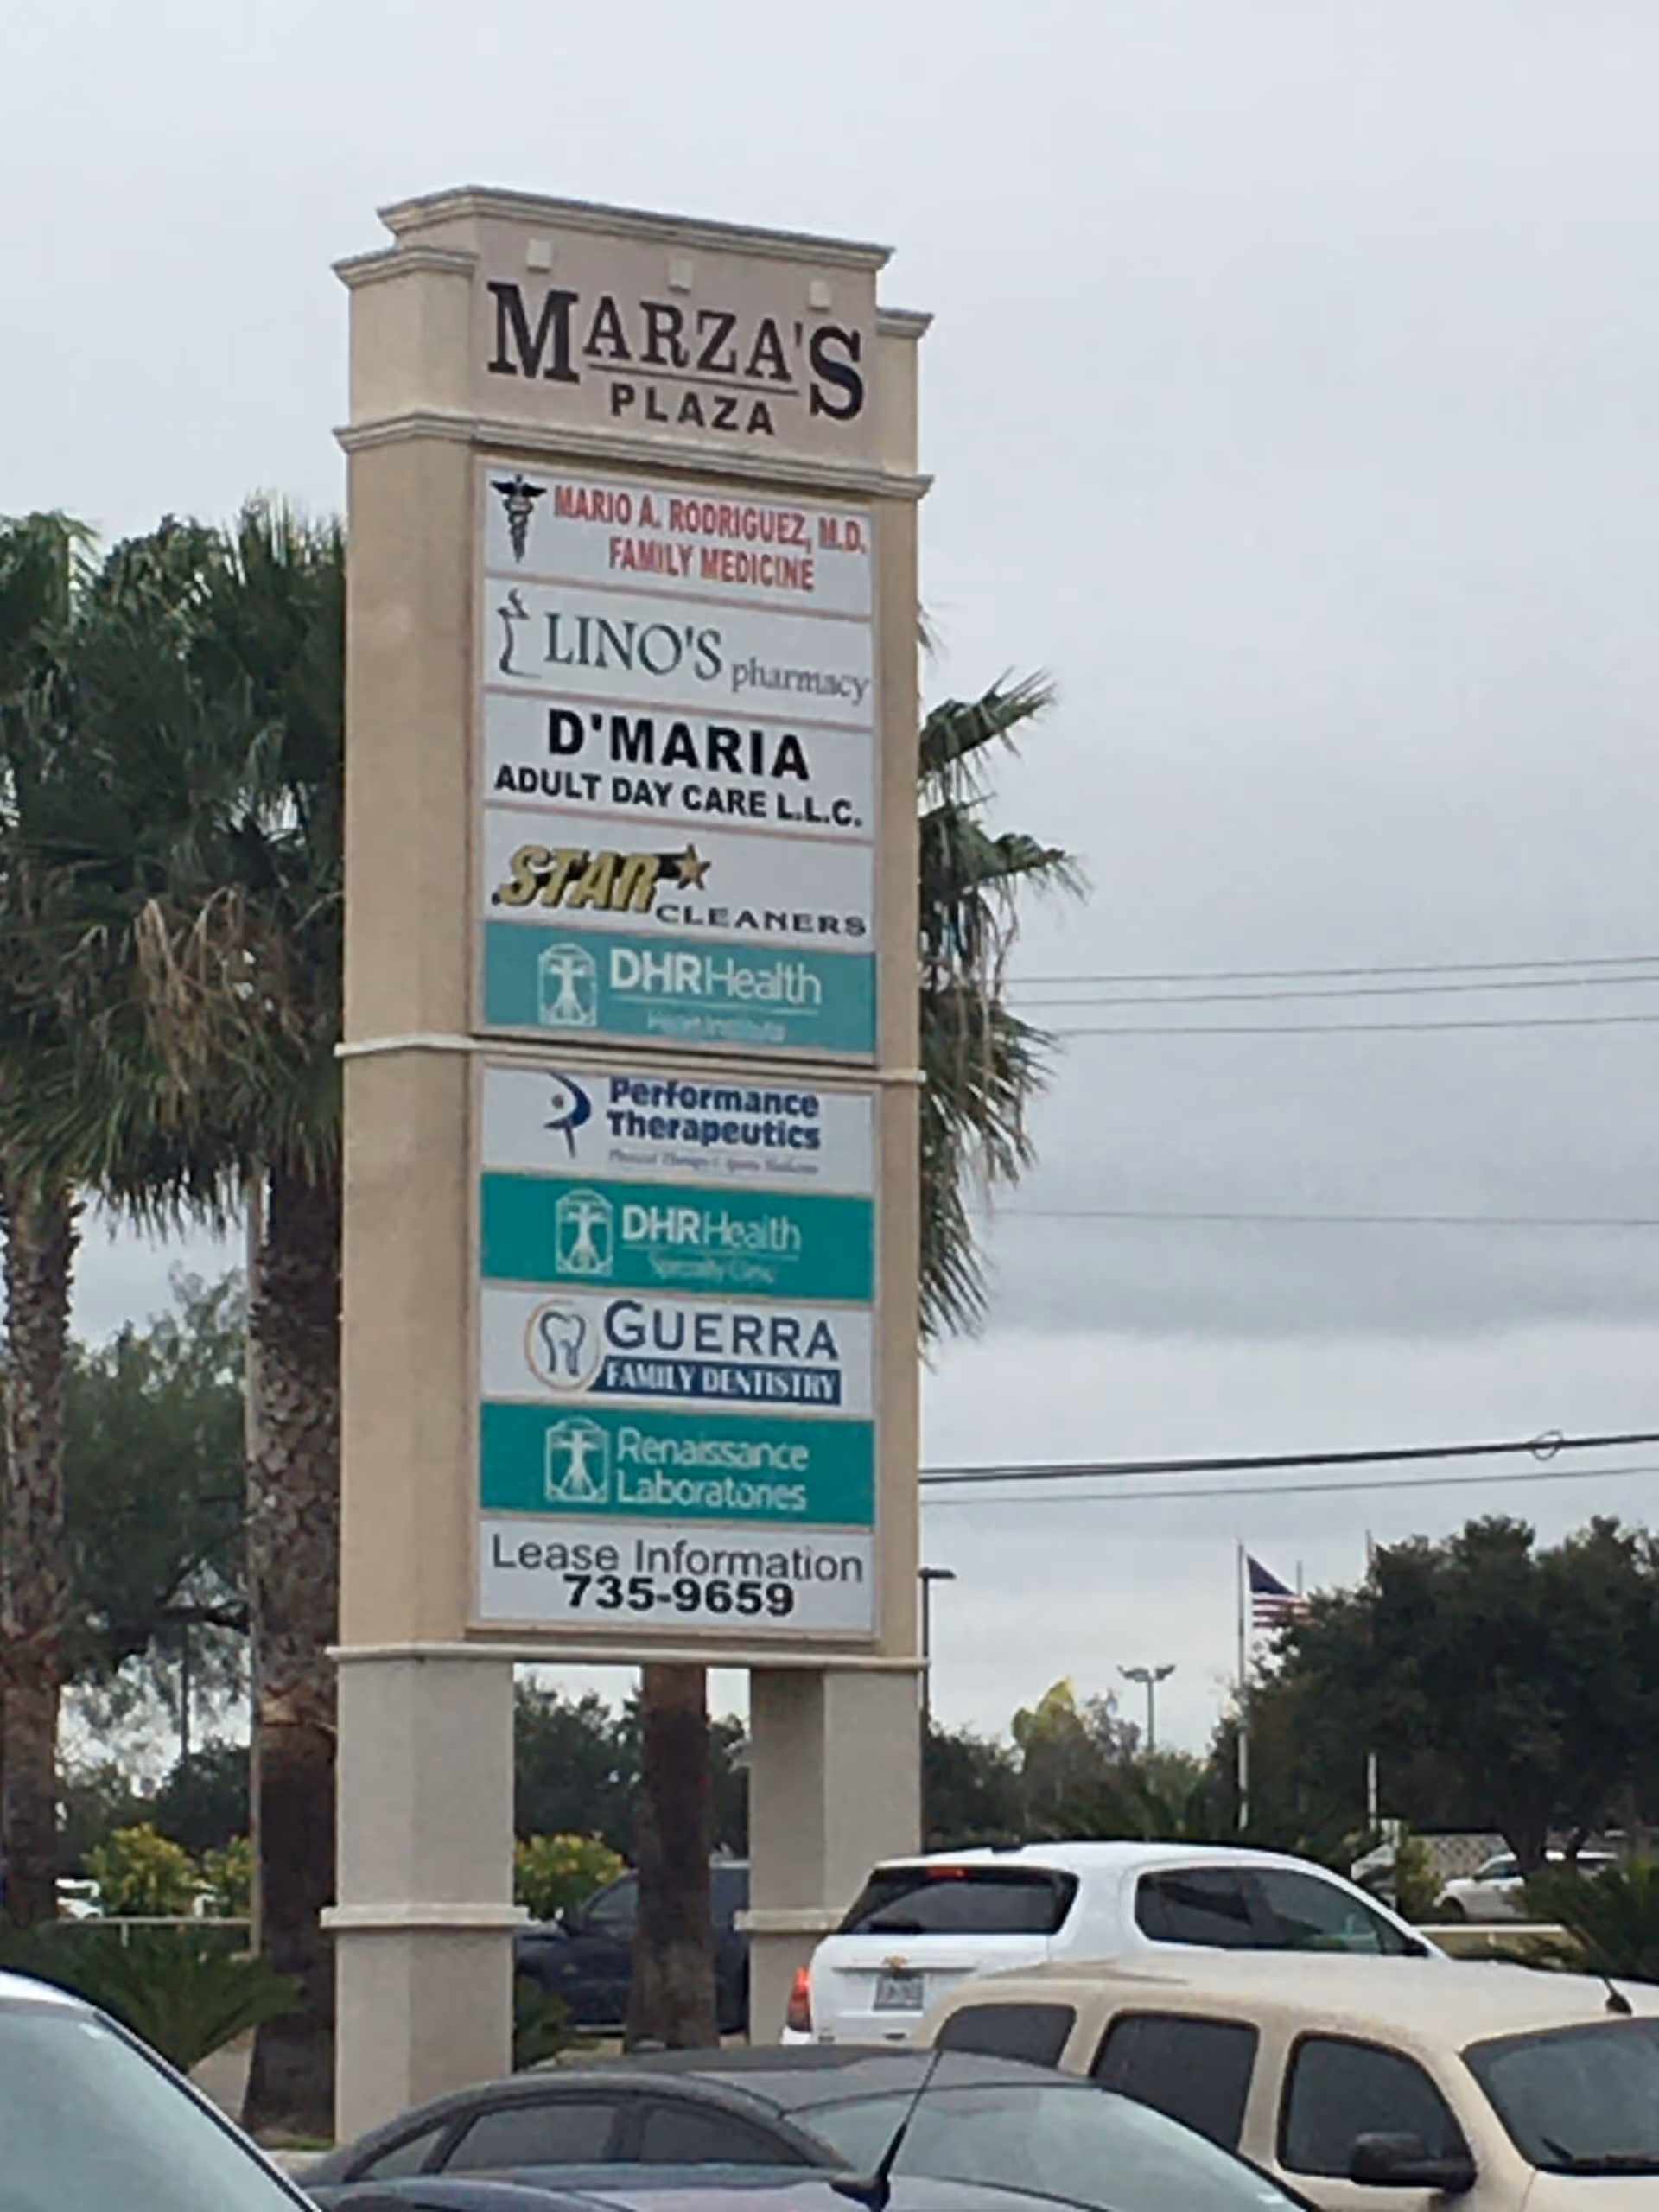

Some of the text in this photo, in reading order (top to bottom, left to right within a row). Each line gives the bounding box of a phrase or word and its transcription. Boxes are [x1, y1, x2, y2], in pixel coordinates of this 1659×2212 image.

[487, 280, 864, 421] MARZA'S
[610, 382, 775, 435] PLAZA
[554, 486, 868, 554] MARIO A. RODRIGUEZ, M.D.
[609, 536, 814, 592] FAMILY MEDICINE
[544, 612, 871, 704] LINO'S pharmacy
[549, 708, 810, 780] D'MARIA
[494, 764, 862, 827] ADULT DAY CARE L.L.C.
[493, 845, 660, 913] STAR
[656, 904, 866, 937] CLEANERS
[609, 1077, 819, 1118] Performance
[607, 1109, 821, 1150] Therapeutics
[605, 1300, 839, 1360] GUERRA
[606, 1362, 835, 1400] FAMILY DENTISTRY
[617, 1426, 809, 1471] Renaissance
[493, 1533, 862, 1583] Lease Information
[563, 1573, 795, 1617] 735-9659
